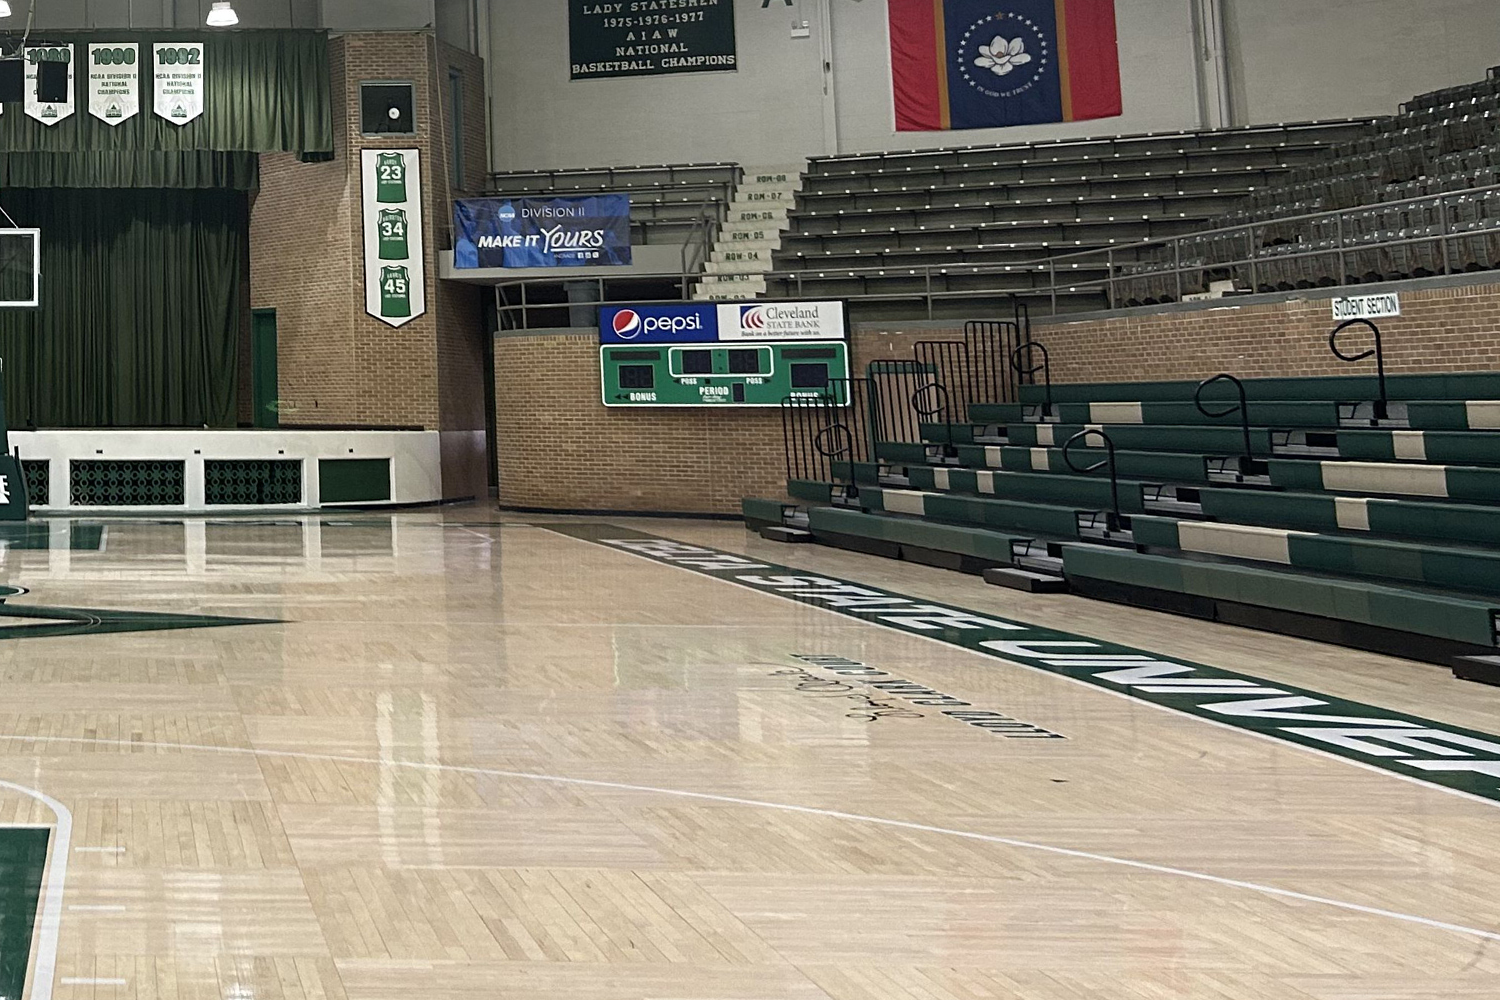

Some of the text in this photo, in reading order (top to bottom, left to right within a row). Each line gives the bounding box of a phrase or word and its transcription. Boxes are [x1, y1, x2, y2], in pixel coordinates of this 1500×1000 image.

[583, 3, 622, 14] LADY
[604, 11, 704, 28] 1975-1976-1977
[92, 48, 136, 65] 1990
[156, 48, 201, 65] 1992
[616, 43, 688, 56] NATIONAL
[572, 55, 735, 74] BASKETBALL CHAMPIONS
[381, 165, 402, 179] 23
[522, 208, 575, 218] DIVISION
[578, 207, 585, 216] II
[382, 222, 404, 236] 34
[478, 224, 604, 253] MAKE IT YOURS
[384, 279, 405, 294] 45
[766, 306, 819, 320] Cleveland
[1334, 296, 1397, 317] STUDENT SECTION
[644, 313, 700, 334] pepsi
[793, 320, 820, 328] BANK
[630, 392, 657, 401] BONUS
[699, 387, 729, 395] PERIOD
[598, 539, 772, 570] DELTA
[735, 575, 1030, 630] STATE
[941, 710, 1069, 739] LLOYD
